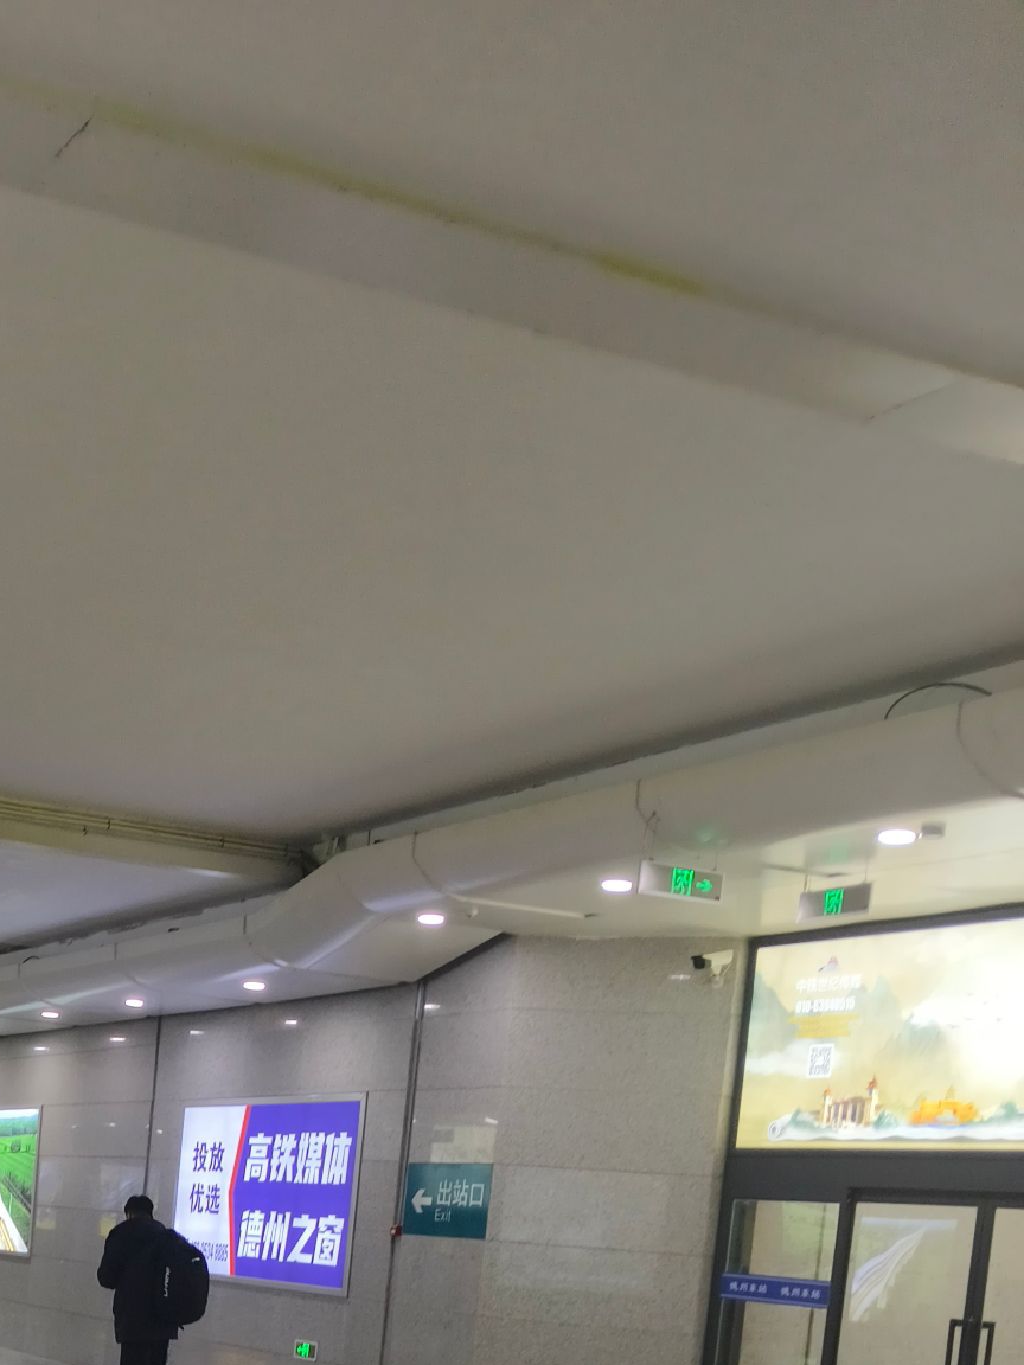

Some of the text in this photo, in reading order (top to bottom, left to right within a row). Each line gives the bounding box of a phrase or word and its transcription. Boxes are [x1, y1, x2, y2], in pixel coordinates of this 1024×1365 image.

[192, 1141, 225, 1173] 投放
[243, 1132, 353, 1185] 高铁媒体
[189, 1183, 221, 1215] 优选
[436, 1178, 485, 1207] 出站口
[434, 1208, 451, 1223] Exit
[237, 1209, 345, 1268] 德州之窗
